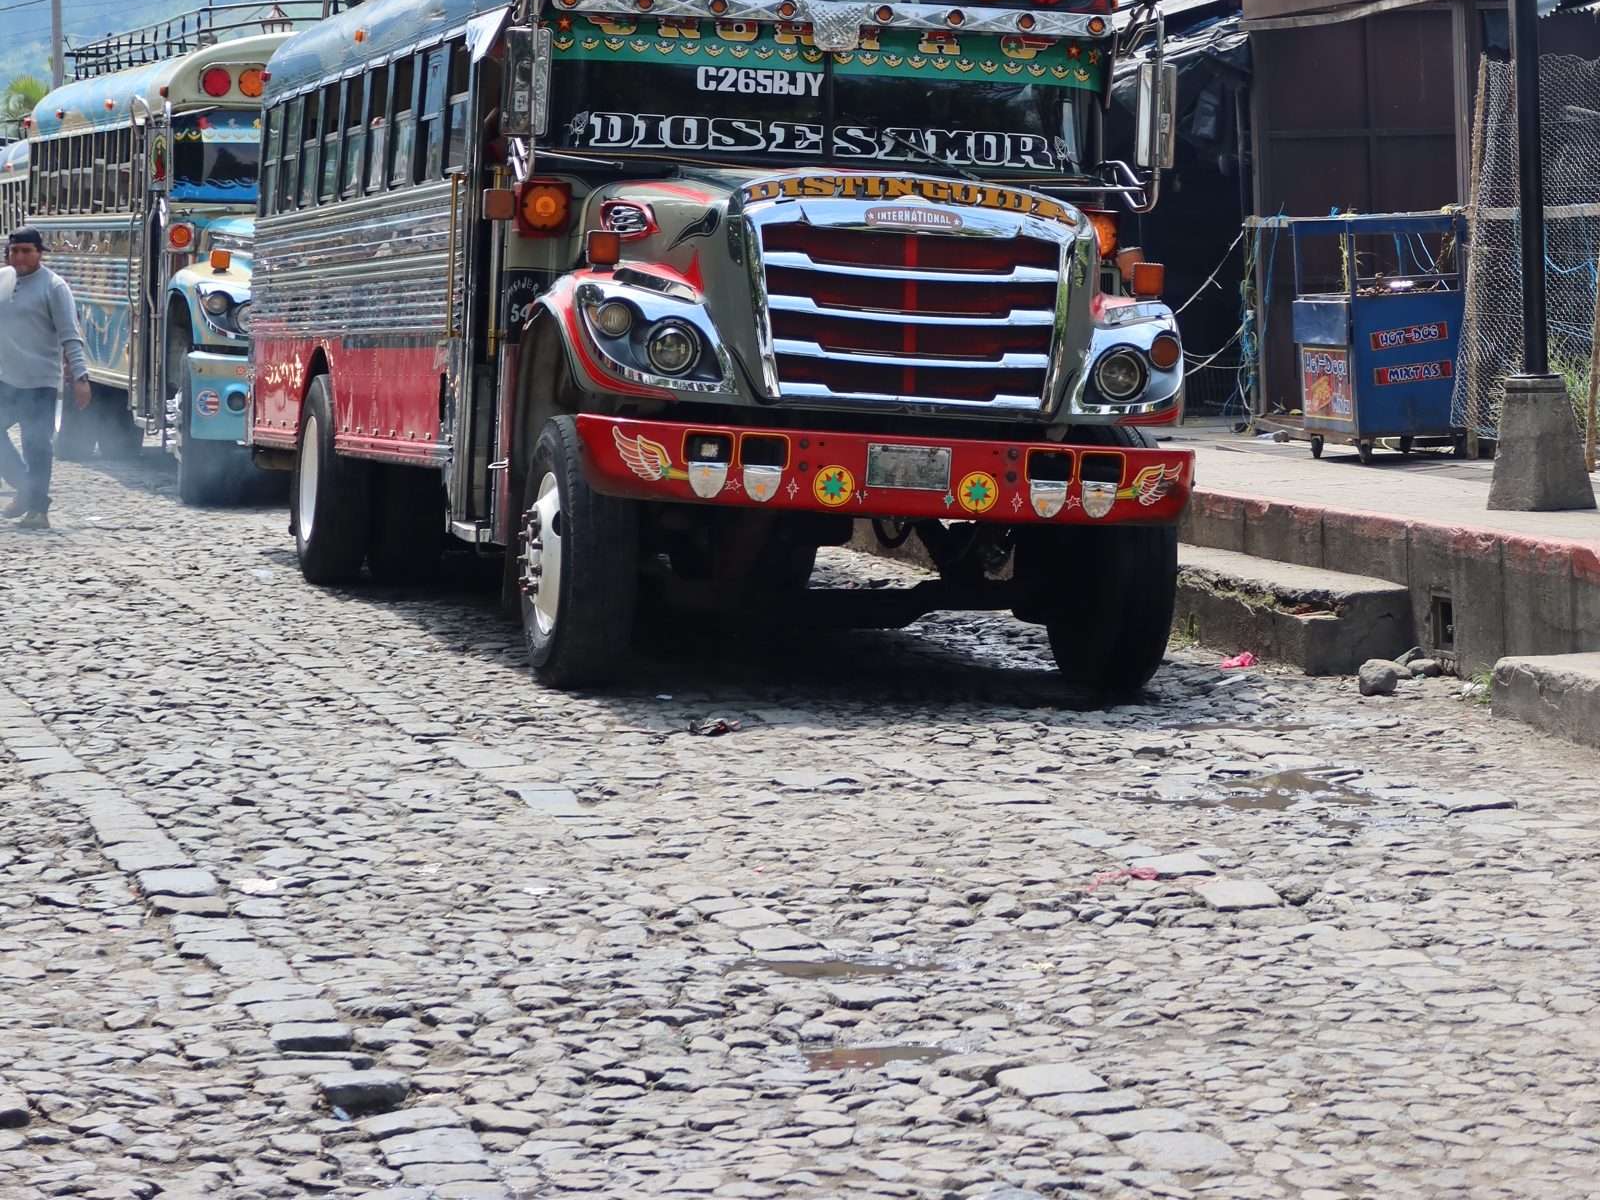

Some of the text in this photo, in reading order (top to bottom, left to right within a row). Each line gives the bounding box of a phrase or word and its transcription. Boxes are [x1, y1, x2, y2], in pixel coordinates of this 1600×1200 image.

[696, 66, 825, 96] C265BJY
[589, 111, 767, 150] DIOS
[745, 175, 1080, 225] DISTINGUIDA
[877, 210, 951, 224] INTERNATIONAL
[1378, 325, 1439, 346] HOT-DOG
[1387, 364, 1441, 383] MIXTAS
